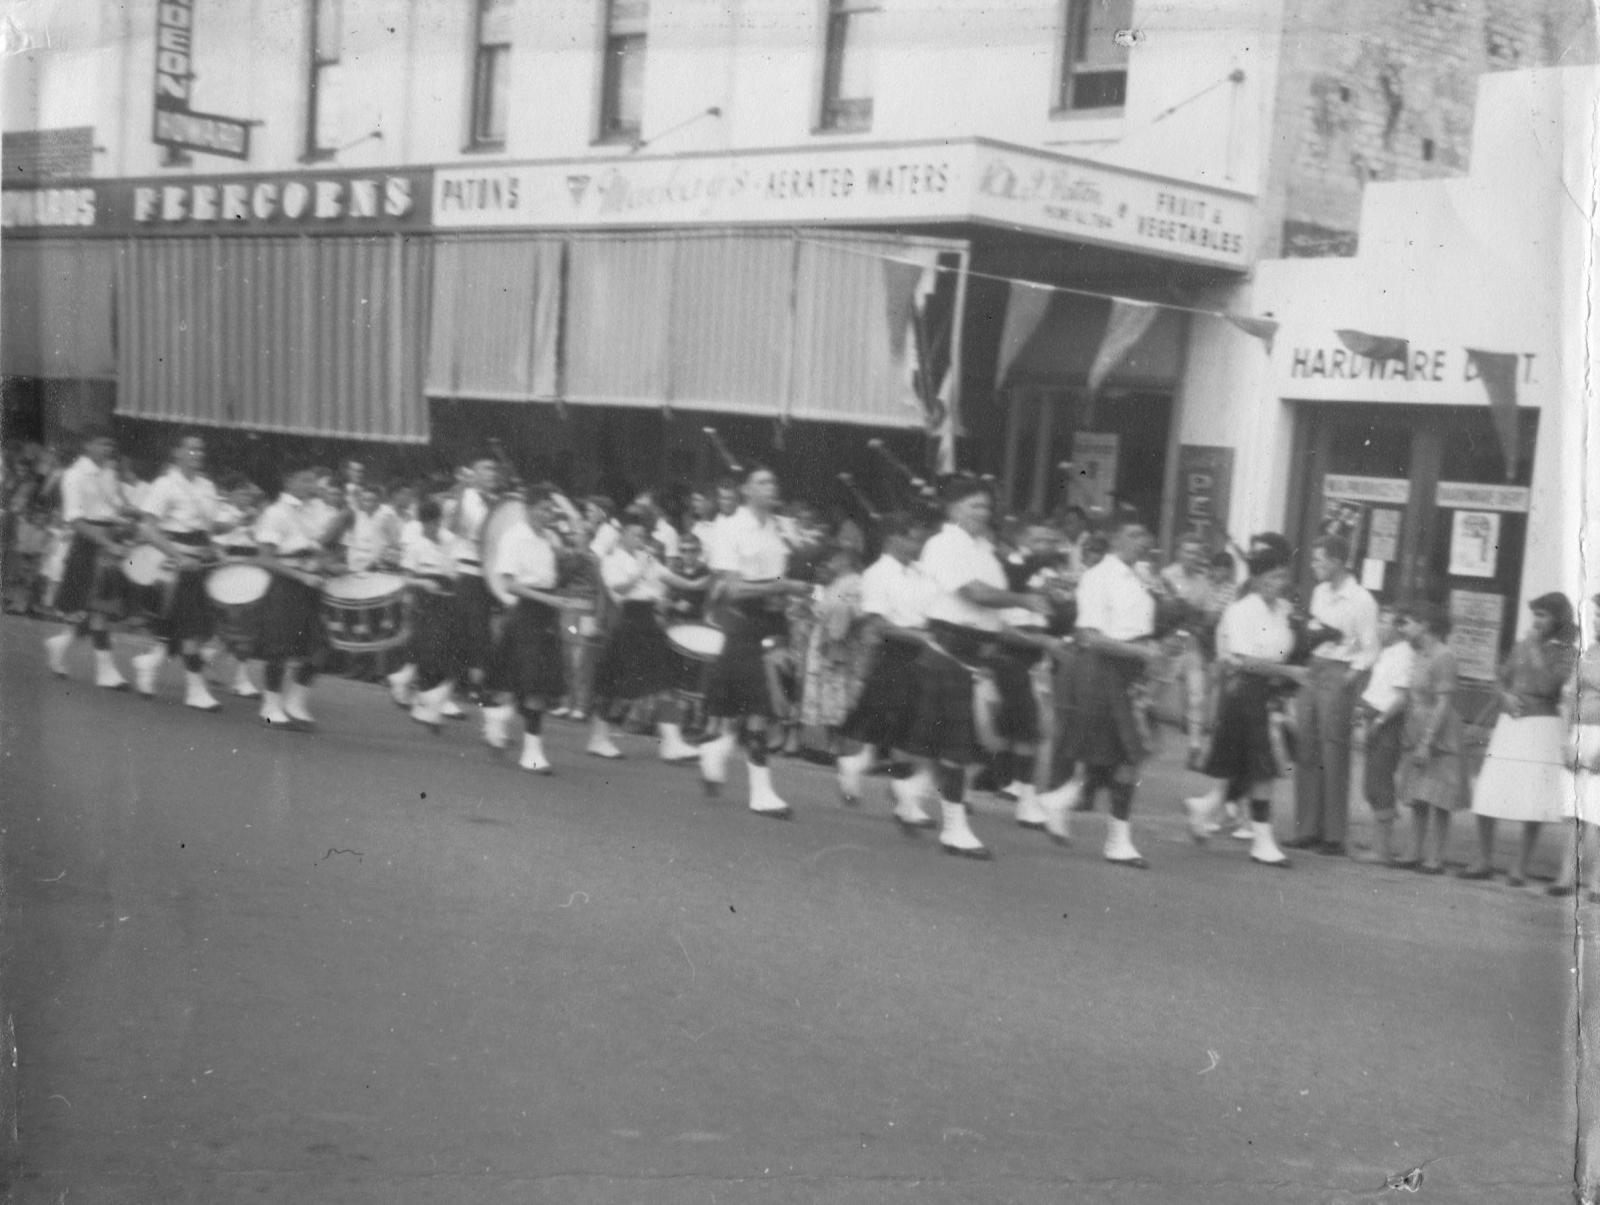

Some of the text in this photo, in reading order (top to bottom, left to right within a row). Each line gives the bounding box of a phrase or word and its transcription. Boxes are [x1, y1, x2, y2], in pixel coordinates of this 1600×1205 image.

[766, 167, 852, 198] AERATED
[867, 162, 949, 194] WATERS
[1157, 192, 1207, 219] FRUIT
[1137, 215, 1244, 254] VEGETABLES
[1464, 351, 1539, 384] DT.
